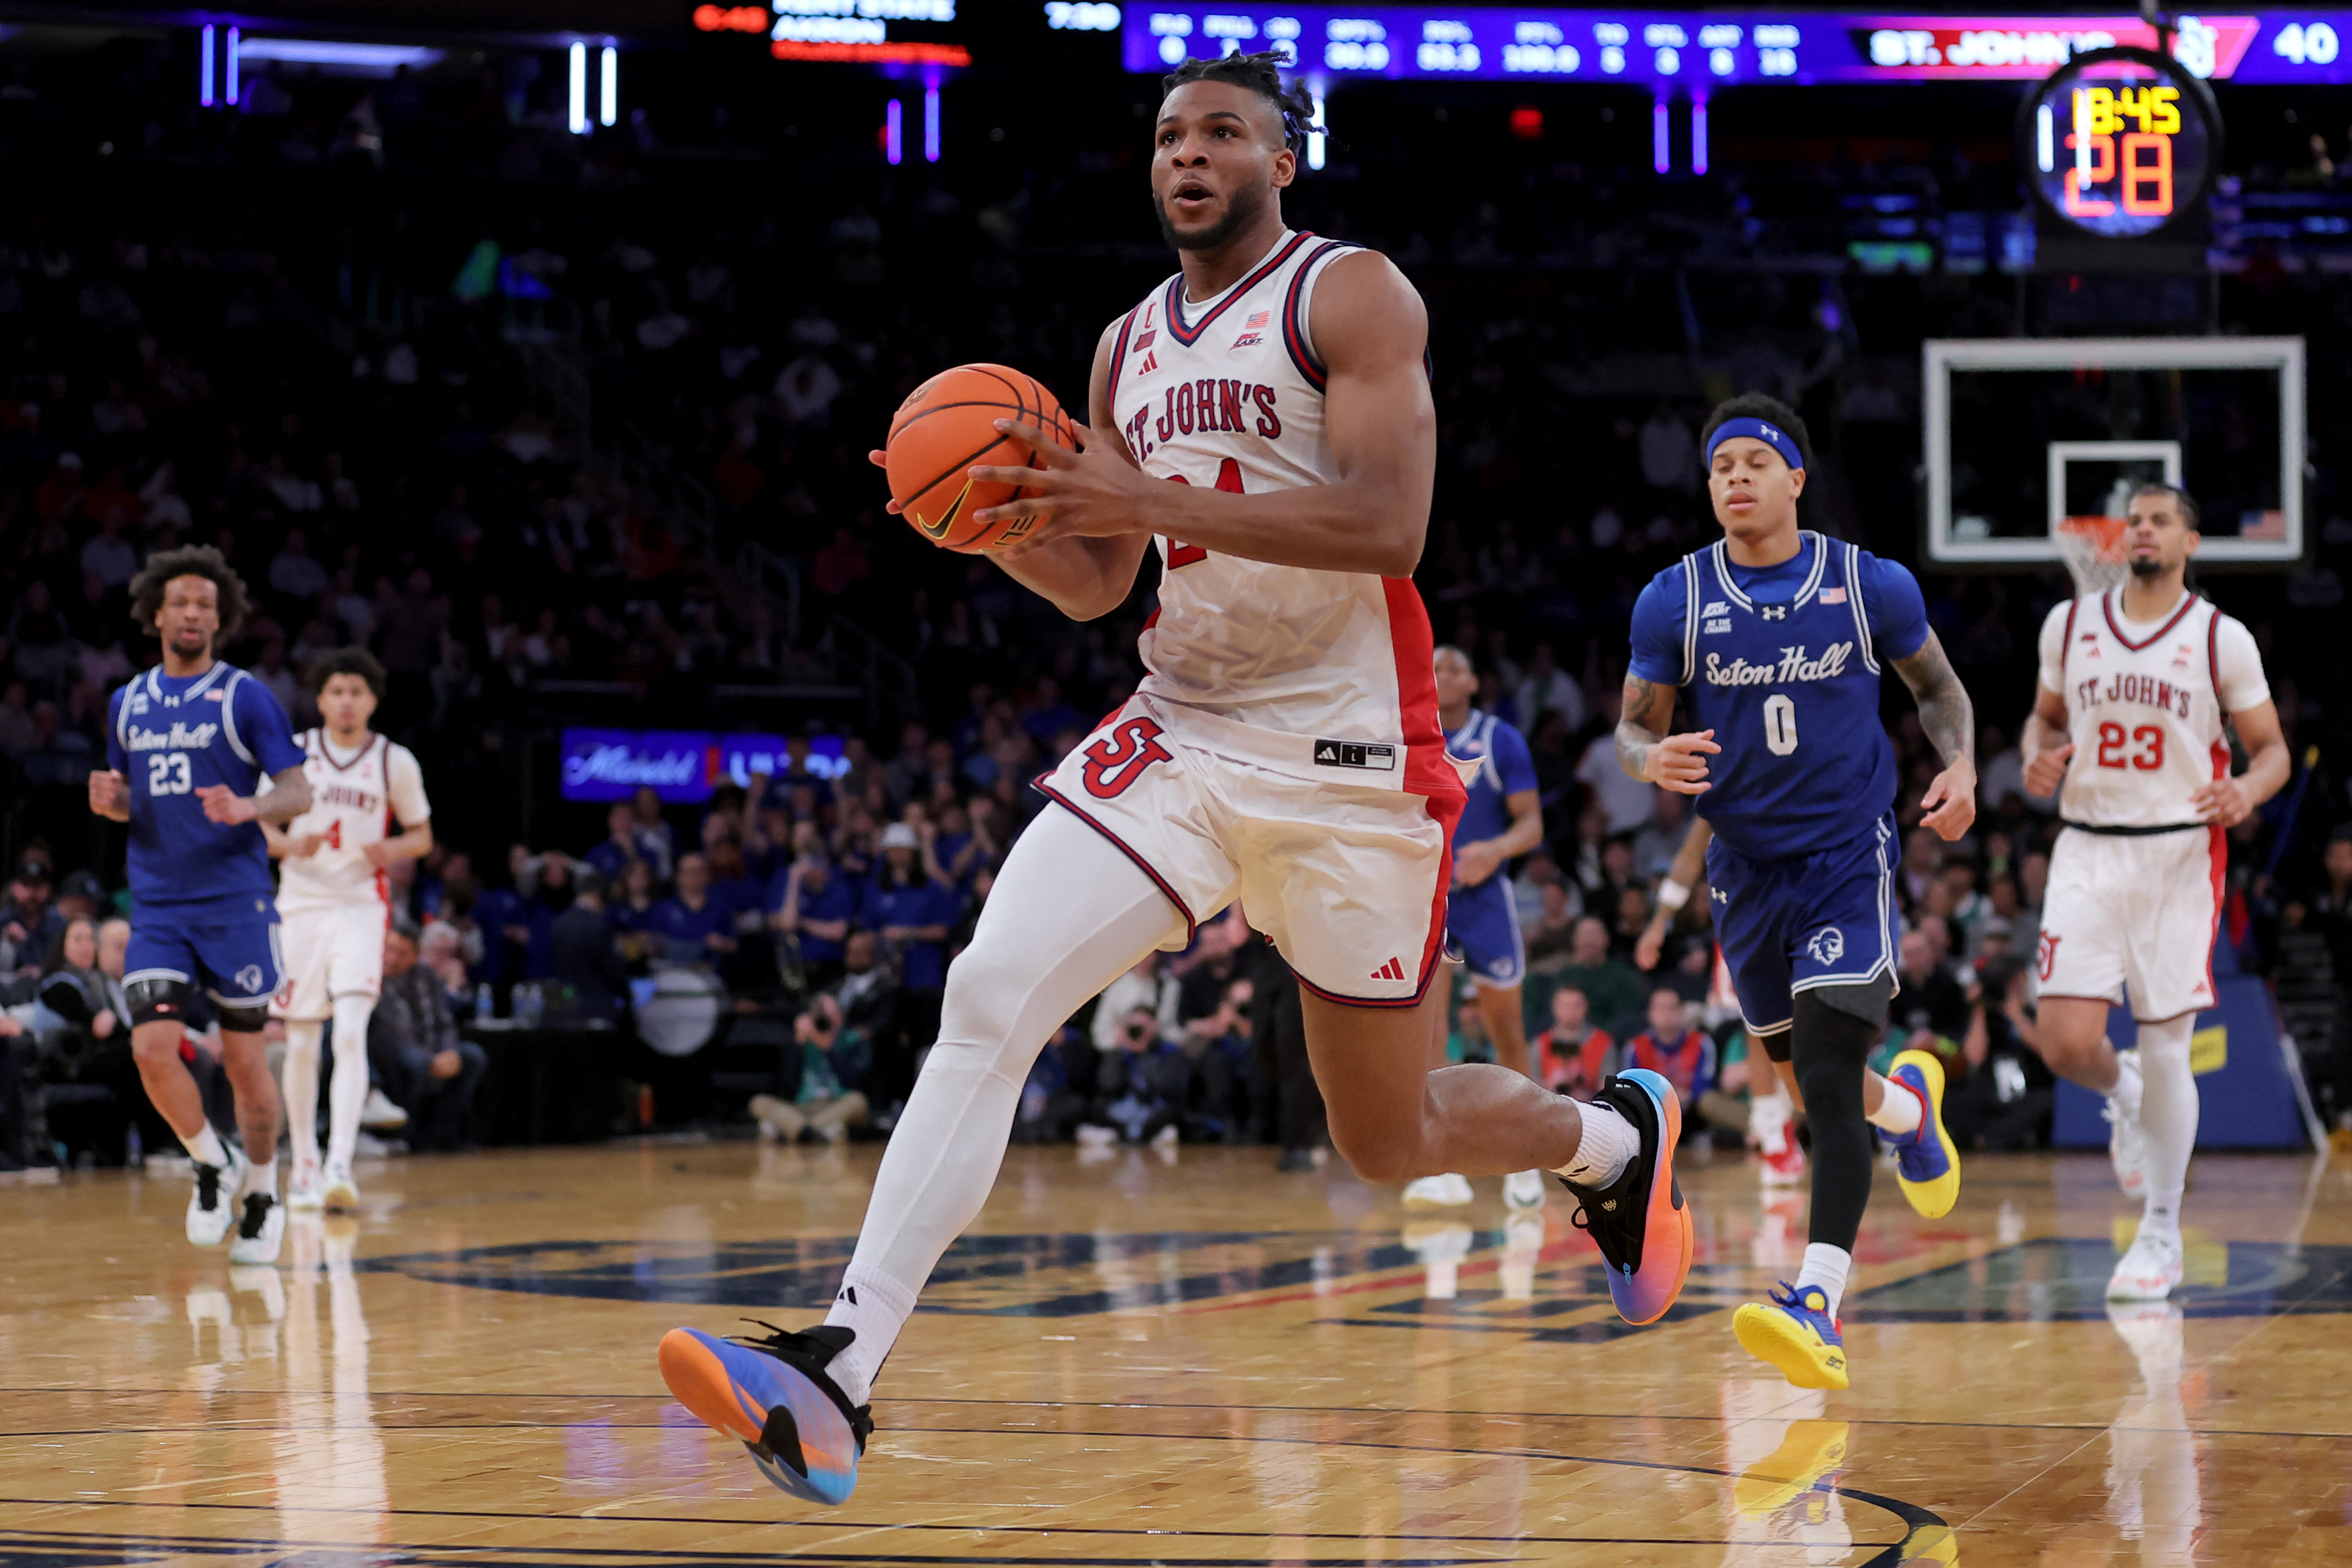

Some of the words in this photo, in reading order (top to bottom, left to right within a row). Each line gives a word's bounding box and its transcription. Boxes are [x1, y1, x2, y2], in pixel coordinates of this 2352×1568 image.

[2273, 23, 2339, 64] 40
[2064, 132, 2173, 217] 28
[1157, 379, 1282, 443] JOHN'S
[1706, 652, 1775, 687] Seton
[1778, 641, 1853, 683] Hall
[2108, 671, 2190, 718] JOHN'S
[1764, 694, 1798, 756] 0
[2099, 722, 2164, 769] 23
[148, 752, 192, 797] 23
